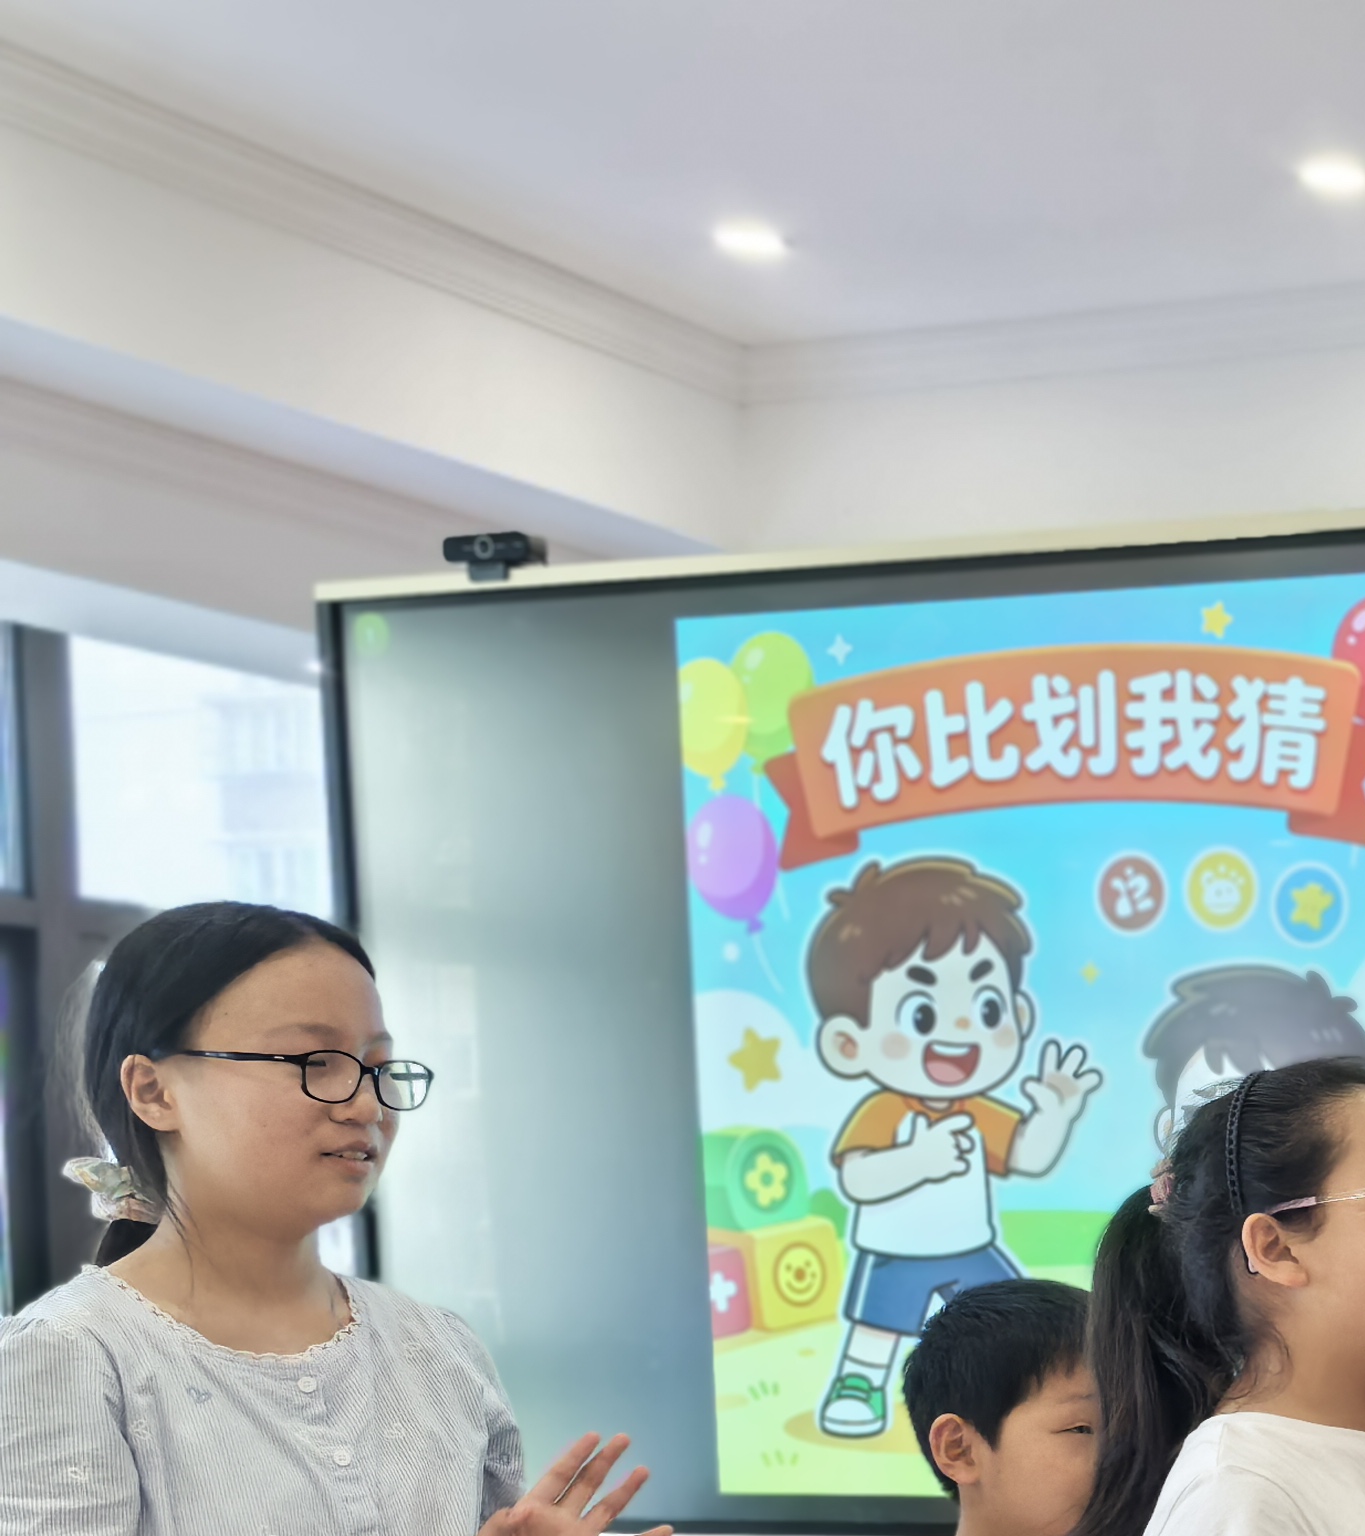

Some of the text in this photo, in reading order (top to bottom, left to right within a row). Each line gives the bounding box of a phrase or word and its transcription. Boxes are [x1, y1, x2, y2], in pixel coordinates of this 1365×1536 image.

[821, 668, 1327, 810] 你比划我猜
